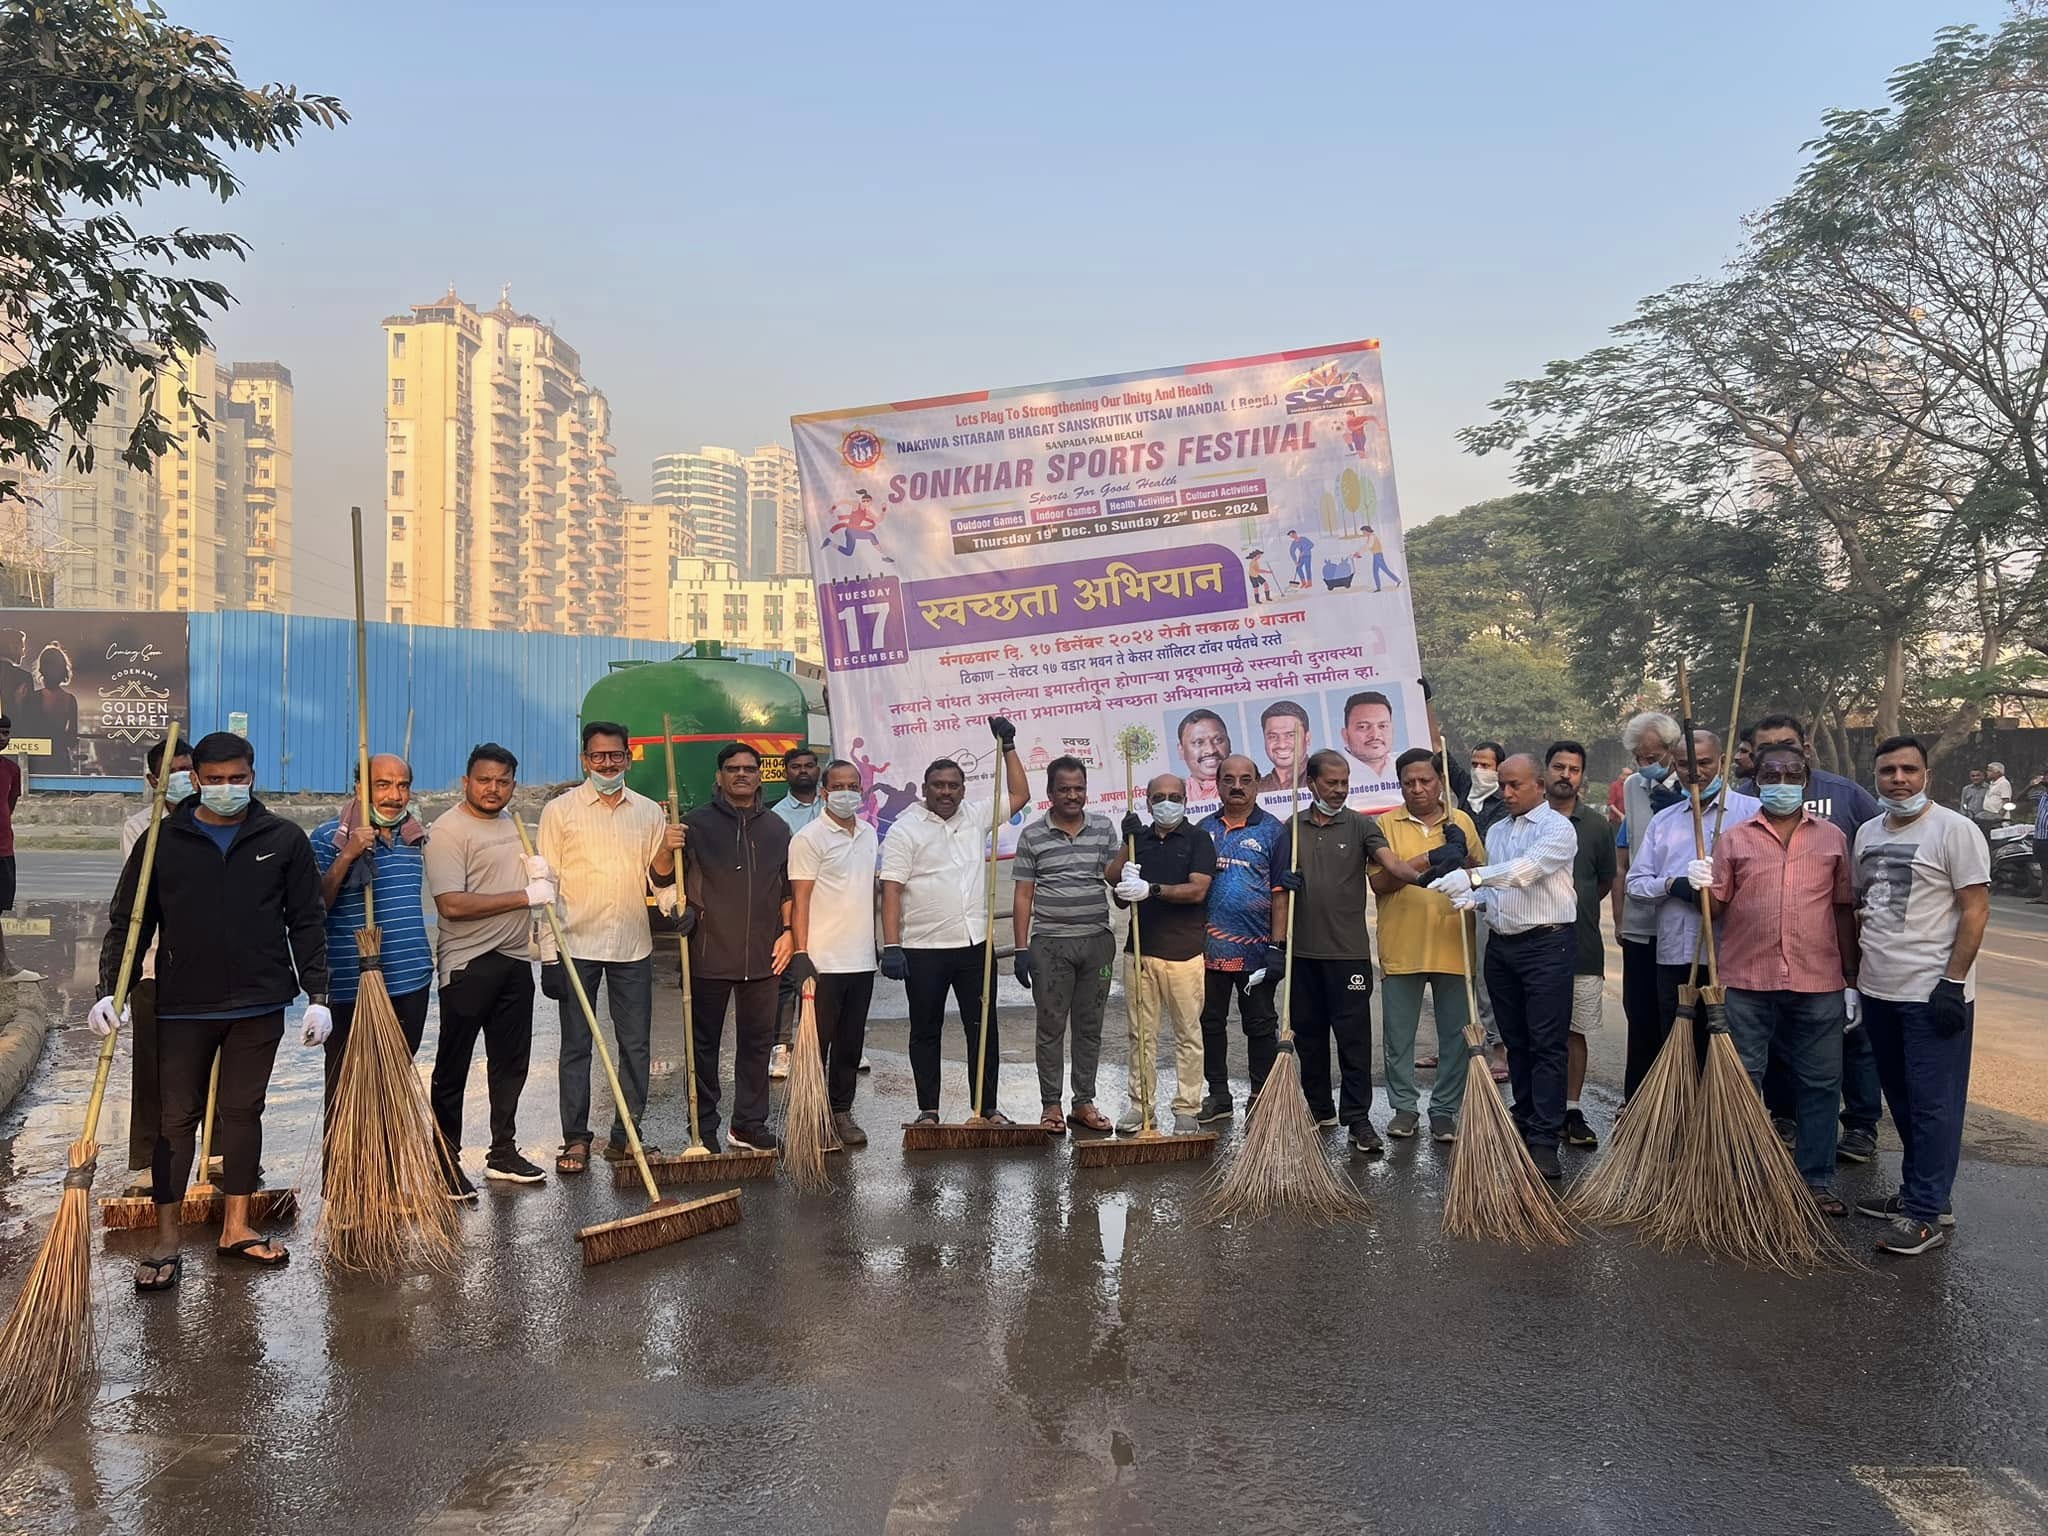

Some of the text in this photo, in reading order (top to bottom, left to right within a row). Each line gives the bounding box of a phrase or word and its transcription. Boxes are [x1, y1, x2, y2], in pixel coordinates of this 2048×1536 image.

[1285, 383, 1372, 405] SSCA
[956, 382, 1213, 427] Lets Play To Strengthening Our Unity And Health
[897, 437, 949, 454] NAKHWA
[952, 430, 1005, 447] SITARAM
[1009, 424, 1055, 440] BHAGAT
[1058, 411, 1132, 433] SANSKRUTIK
[1136, 408, 1173, 424] UTSAV
[1177, 400, 1227, 418] MANDAL
[1045, 430, 1143, 450] SANPADA PALM BEACH
[888, 421, 1316, 503] SONKHAR SPORTS FESTIVAL
[1028, 474, 1177, 504] Sports For Good Health
[1185, 484, 1259, 501] Cultural Activities
[1110, 494, 1175, 511] Health Activities
[956, 514, 1024, 531] Outdoor Games
[1036, 505, 1097, 521] Indoor Games
[972, 532, 1032, 549] Thursday
[1062, 525, 1091, 538] Dec.
[1094, 522, 1108, 534] to
[1111, 516, 1159, 532] Sunday
[1192, 508, 1221, 521] Dec.
[1225, 502, 1259, 516] 2024
[837, 587, 891, 602] TUESDAY
[918, 561, 1224, 630] स्वच्छता अभियान
[838, 602, 890, 653] 17
[939, 650, 999, 668] मंगळवार
[1108, 628, 1154, 647] २०२४
[1159, 624, 1191, 640] रोजी
[1196, 617, 1240, 634] सकाळ
[1244, 614, 1255, 628] ७
[1260, 610, 1306, 626] वाजता
[106, 643, 140, 662] Coming
[834, 650, 905, 667] DECEMBER
[959, 669, 994, 685] ठिकाण
[1008, 663, 1038, 679] सेक्टर
[1042, 662, 1057, 675] १७
[1061, 659, 1086, 672] वडार
[1089, 656, 1113, 669] भवन
[1116, 651, 1125, 665] ते
[1128, 649, 1153, 664] केसर
[1262, 631, 1282, 646] रस्ते
[111, 668, 158, 681] CODENAME
[977, 686, 1039, 706] असलेल्या
[1043, 677, 1110, 698] इमारतीतून
[1174, 657, 1244, 683] प्रदूषणामुळे
[1249, 650, 1303, 671] रस्त्याची
[1307, 646, 1363, 668] दुरावस्था
[102, 702, 168, 714] GOLDEN
[892, 716, 928, 737] झाली
[933, 713, 961, 731] आहे
[1031, 696, 1101, 720] प्रभागामध्ये
[1106, 693, 1158, 711] स्वच्छता
[1164, 677, 1251, 703] अभियानामध्ये
[1304, 666, 1349, 685] सामील
[102, 714, 169, 726] CARPET
[1350, 785, 1380, 794] andeep
[1186, 803, 1217, 814] ashrath
